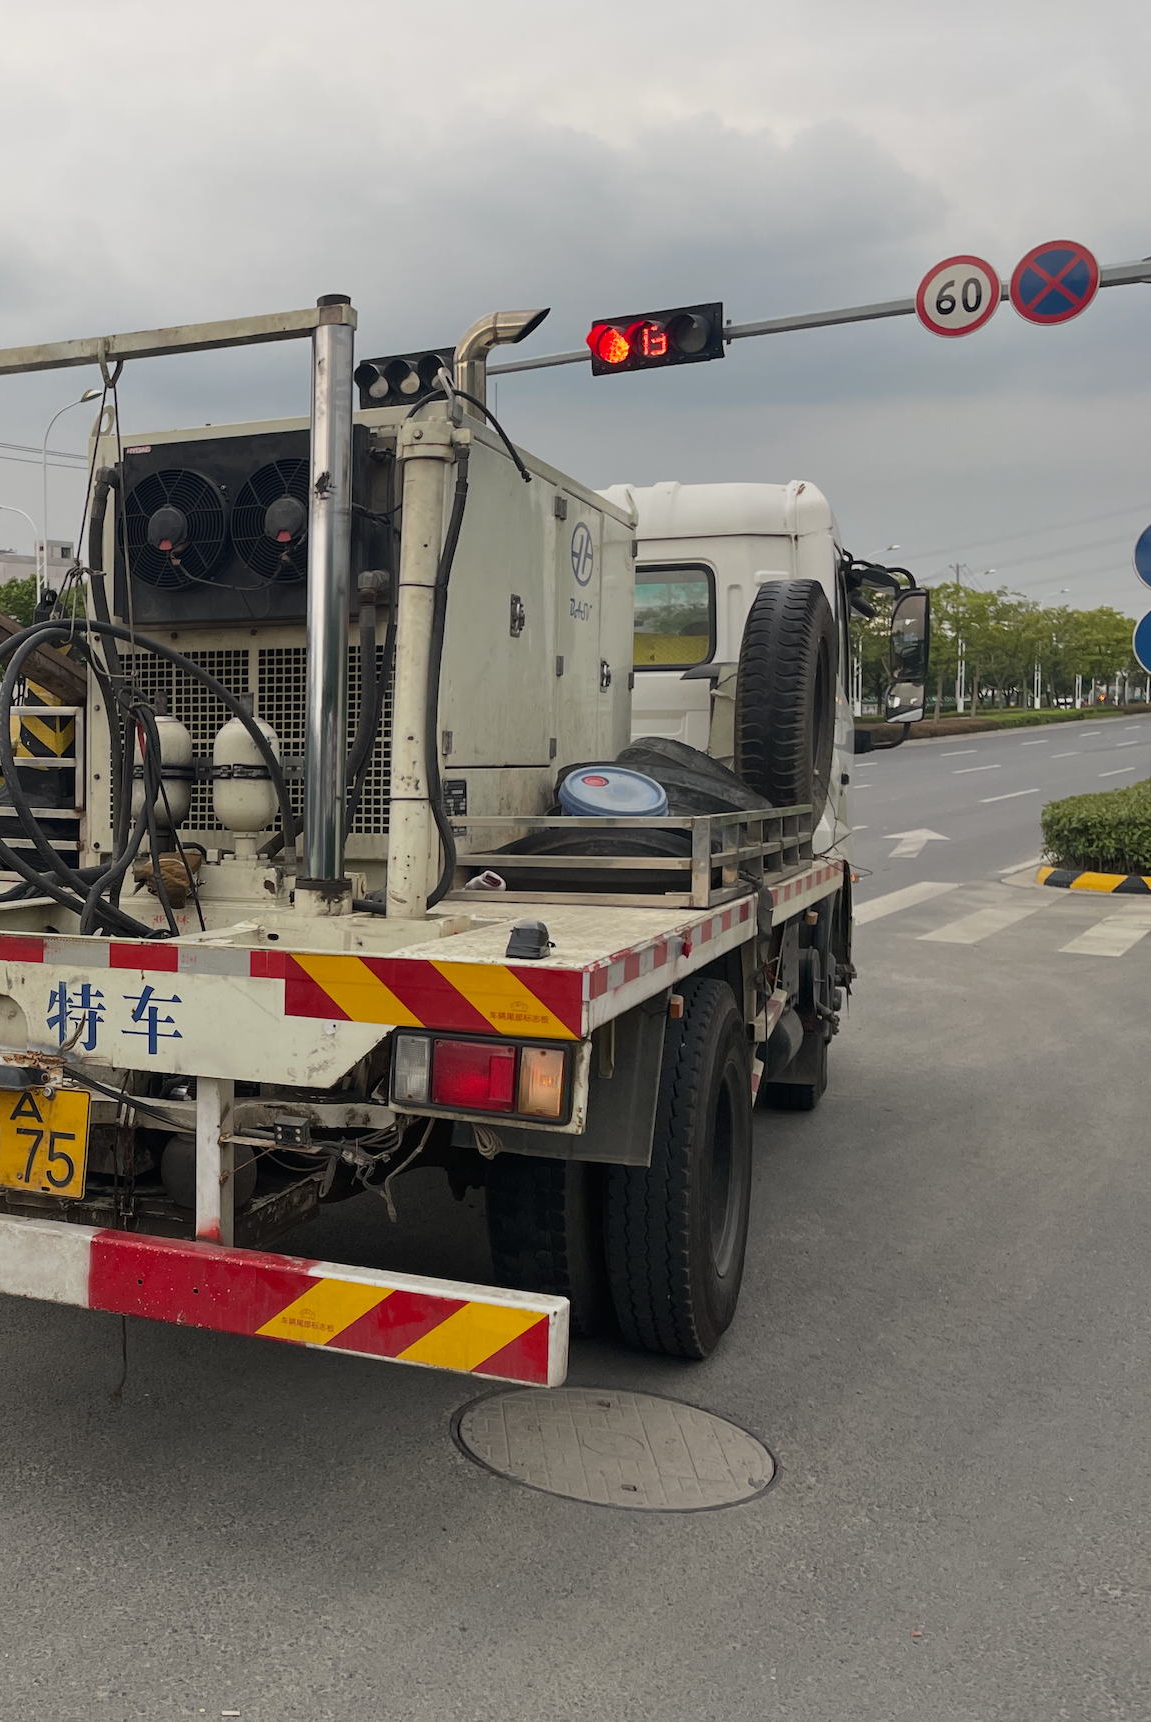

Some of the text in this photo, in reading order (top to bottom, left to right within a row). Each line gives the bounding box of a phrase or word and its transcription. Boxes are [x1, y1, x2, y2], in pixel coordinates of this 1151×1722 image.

[936, 277, 982, 315] 60
[489, 1011, 549, 1024] 车辆尾部标志板
[281, 1316, 335, 1333] 车辆尾部标志板
